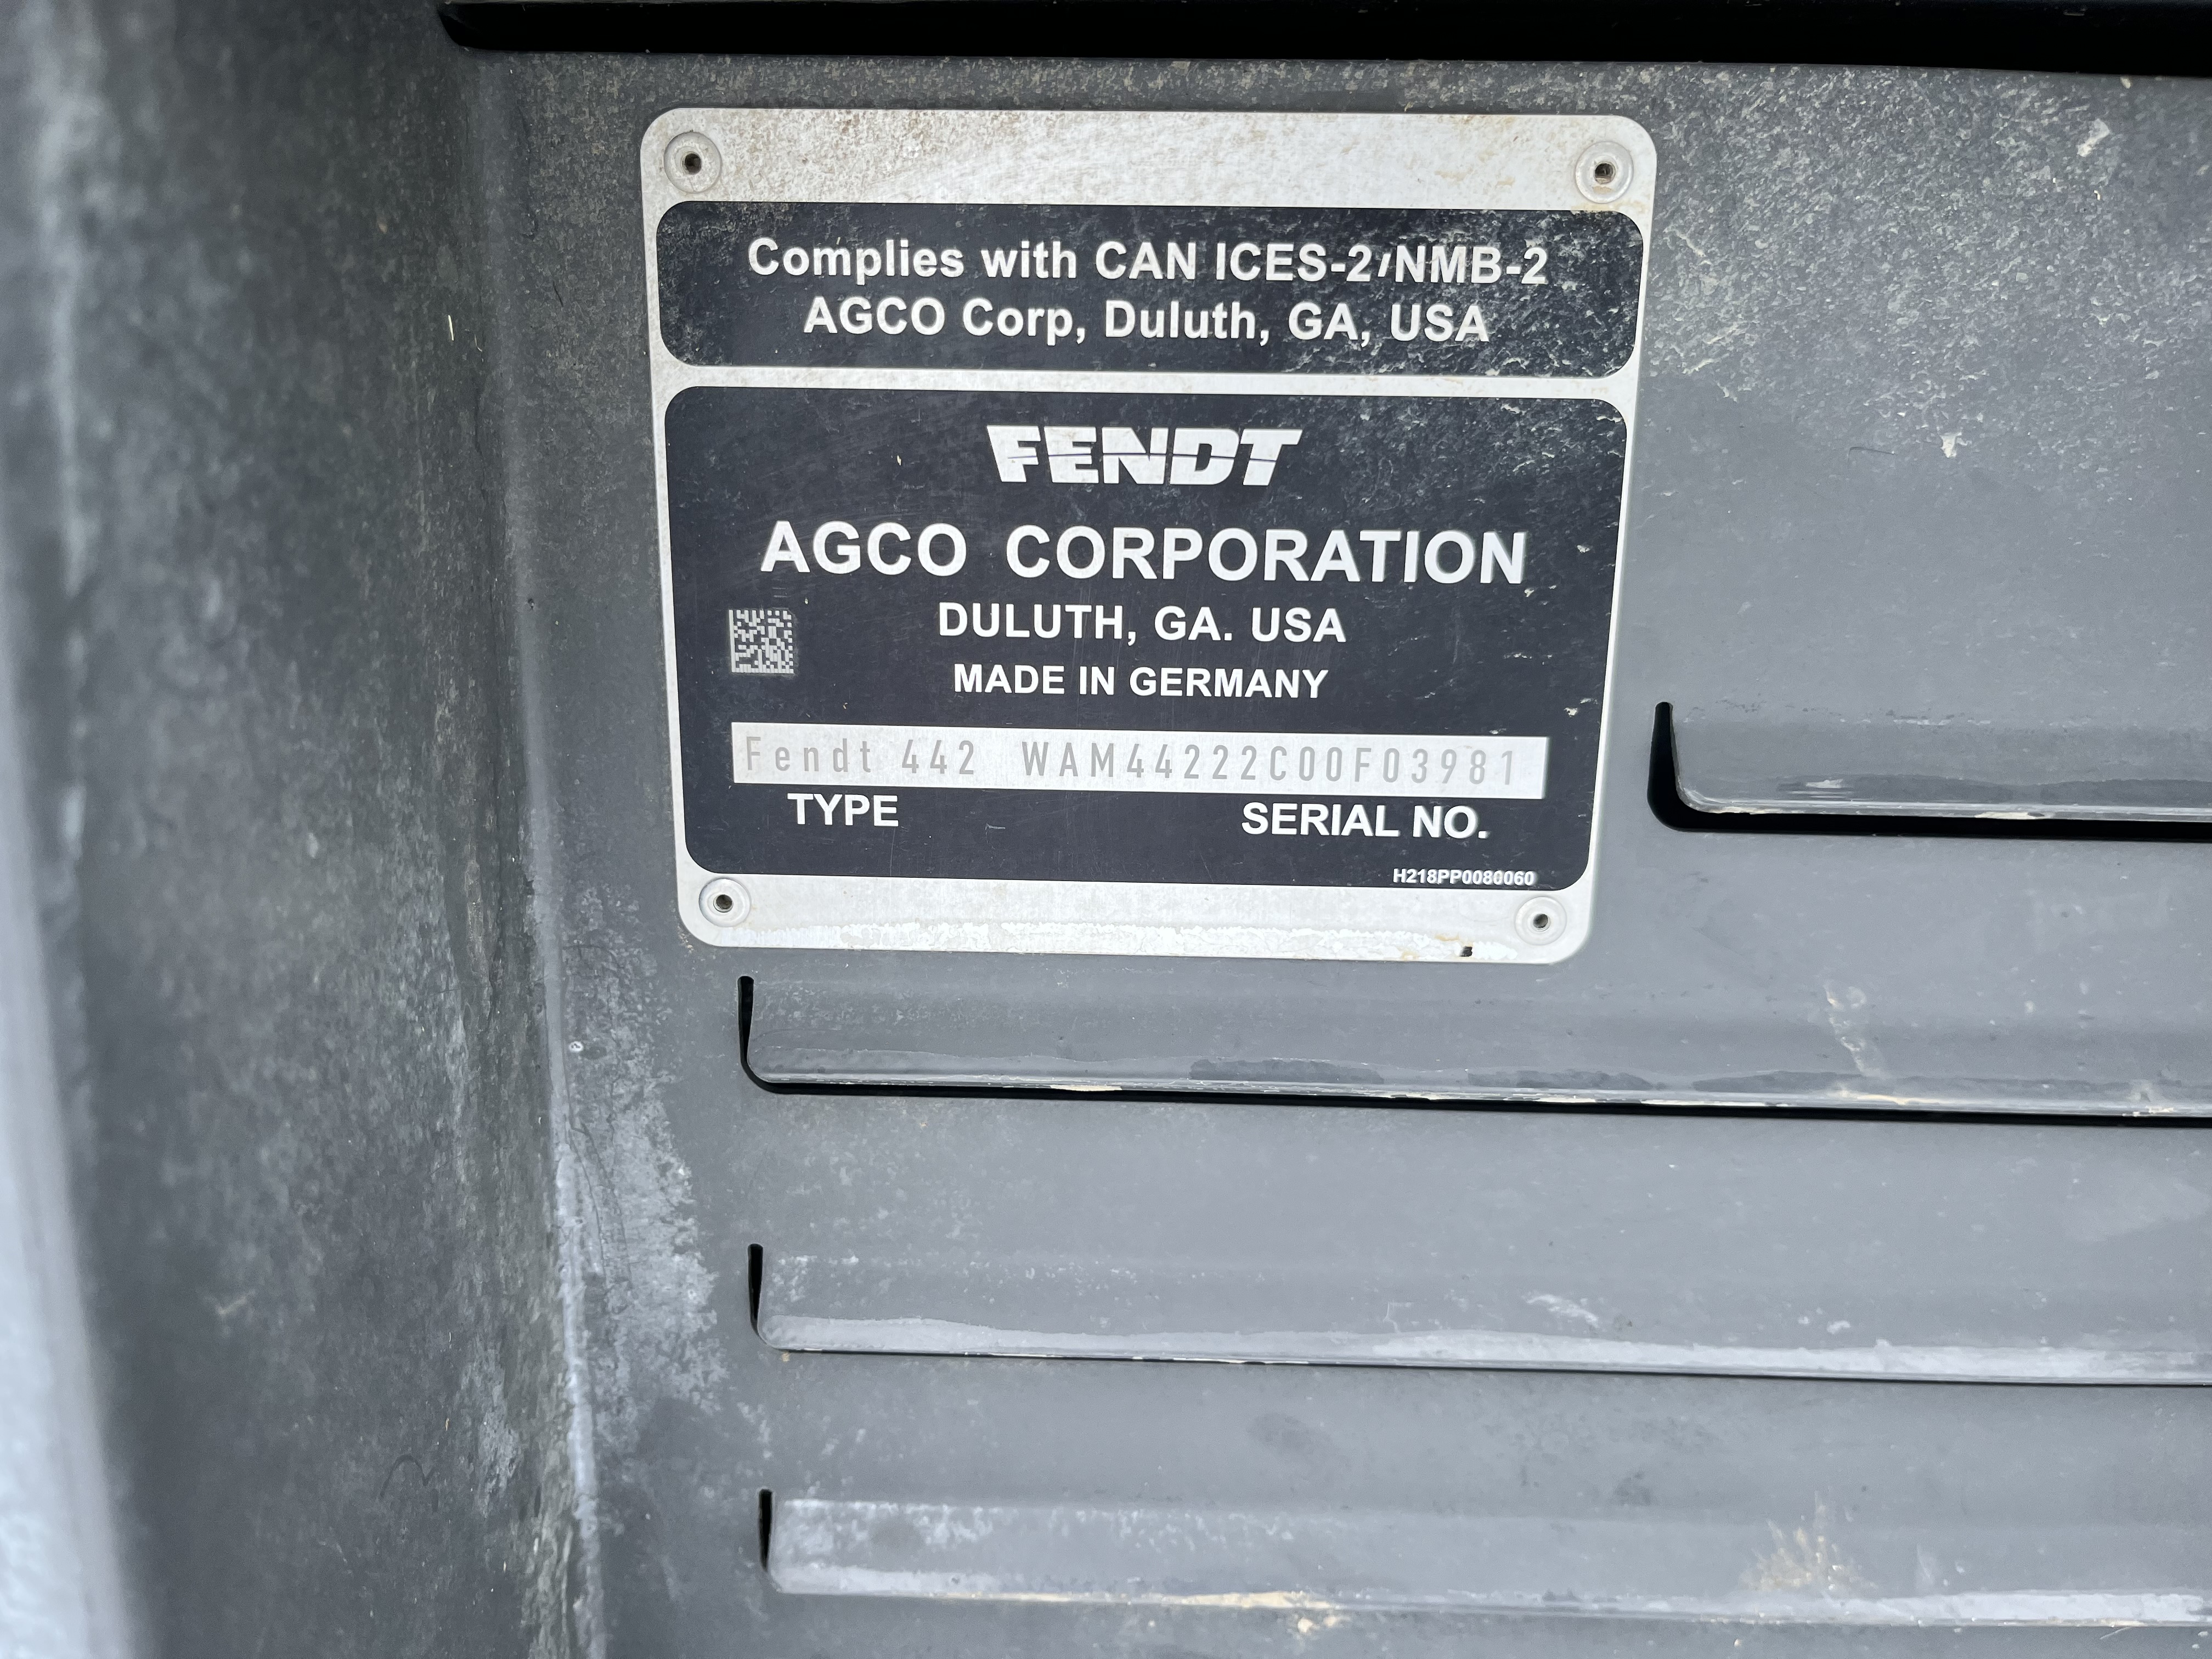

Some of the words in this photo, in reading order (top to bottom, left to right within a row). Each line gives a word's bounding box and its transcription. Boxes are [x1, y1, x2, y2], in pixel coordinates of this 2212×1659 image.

[747, 237, 965, 286] Complies
[980, 240, 1077, 279] with
[1095, 241, 1197, 281] CAN
[803, 296, 946, 336] AGCO
[962, 298, 1086, 346] Corp,
[1105, 301, 1270, 346] Duluth,
[1288, 302, 1372, 348] GA,
[1390, 304, 1490, 342] USA
[986, 425, 1302, 486] FENDT
[760, 520, 967, 577] AGCO
[1006, 524, 1527, 584] CORPORATION
[938, 601, 1137, 646] DULUTH,
[1154, 605, 1234, 642] GA.
[1251, 607, 1347, 643] USA
[953, 663, 1065, 695] MADE
[1079, 665, 1115, 696] IN
[1128, 666, 1329, 698] GERMANY
[745, 736, 872, 774] Fendt
[901, 740, 976, 775] 442
[1021, 741, 1515, 785] WAM44222C00F03981
[787, 792, 900, 827] TYPE
[1240, 801, 1400, 837] SERIAL
[1412, 805, 1489, 839] NO.
